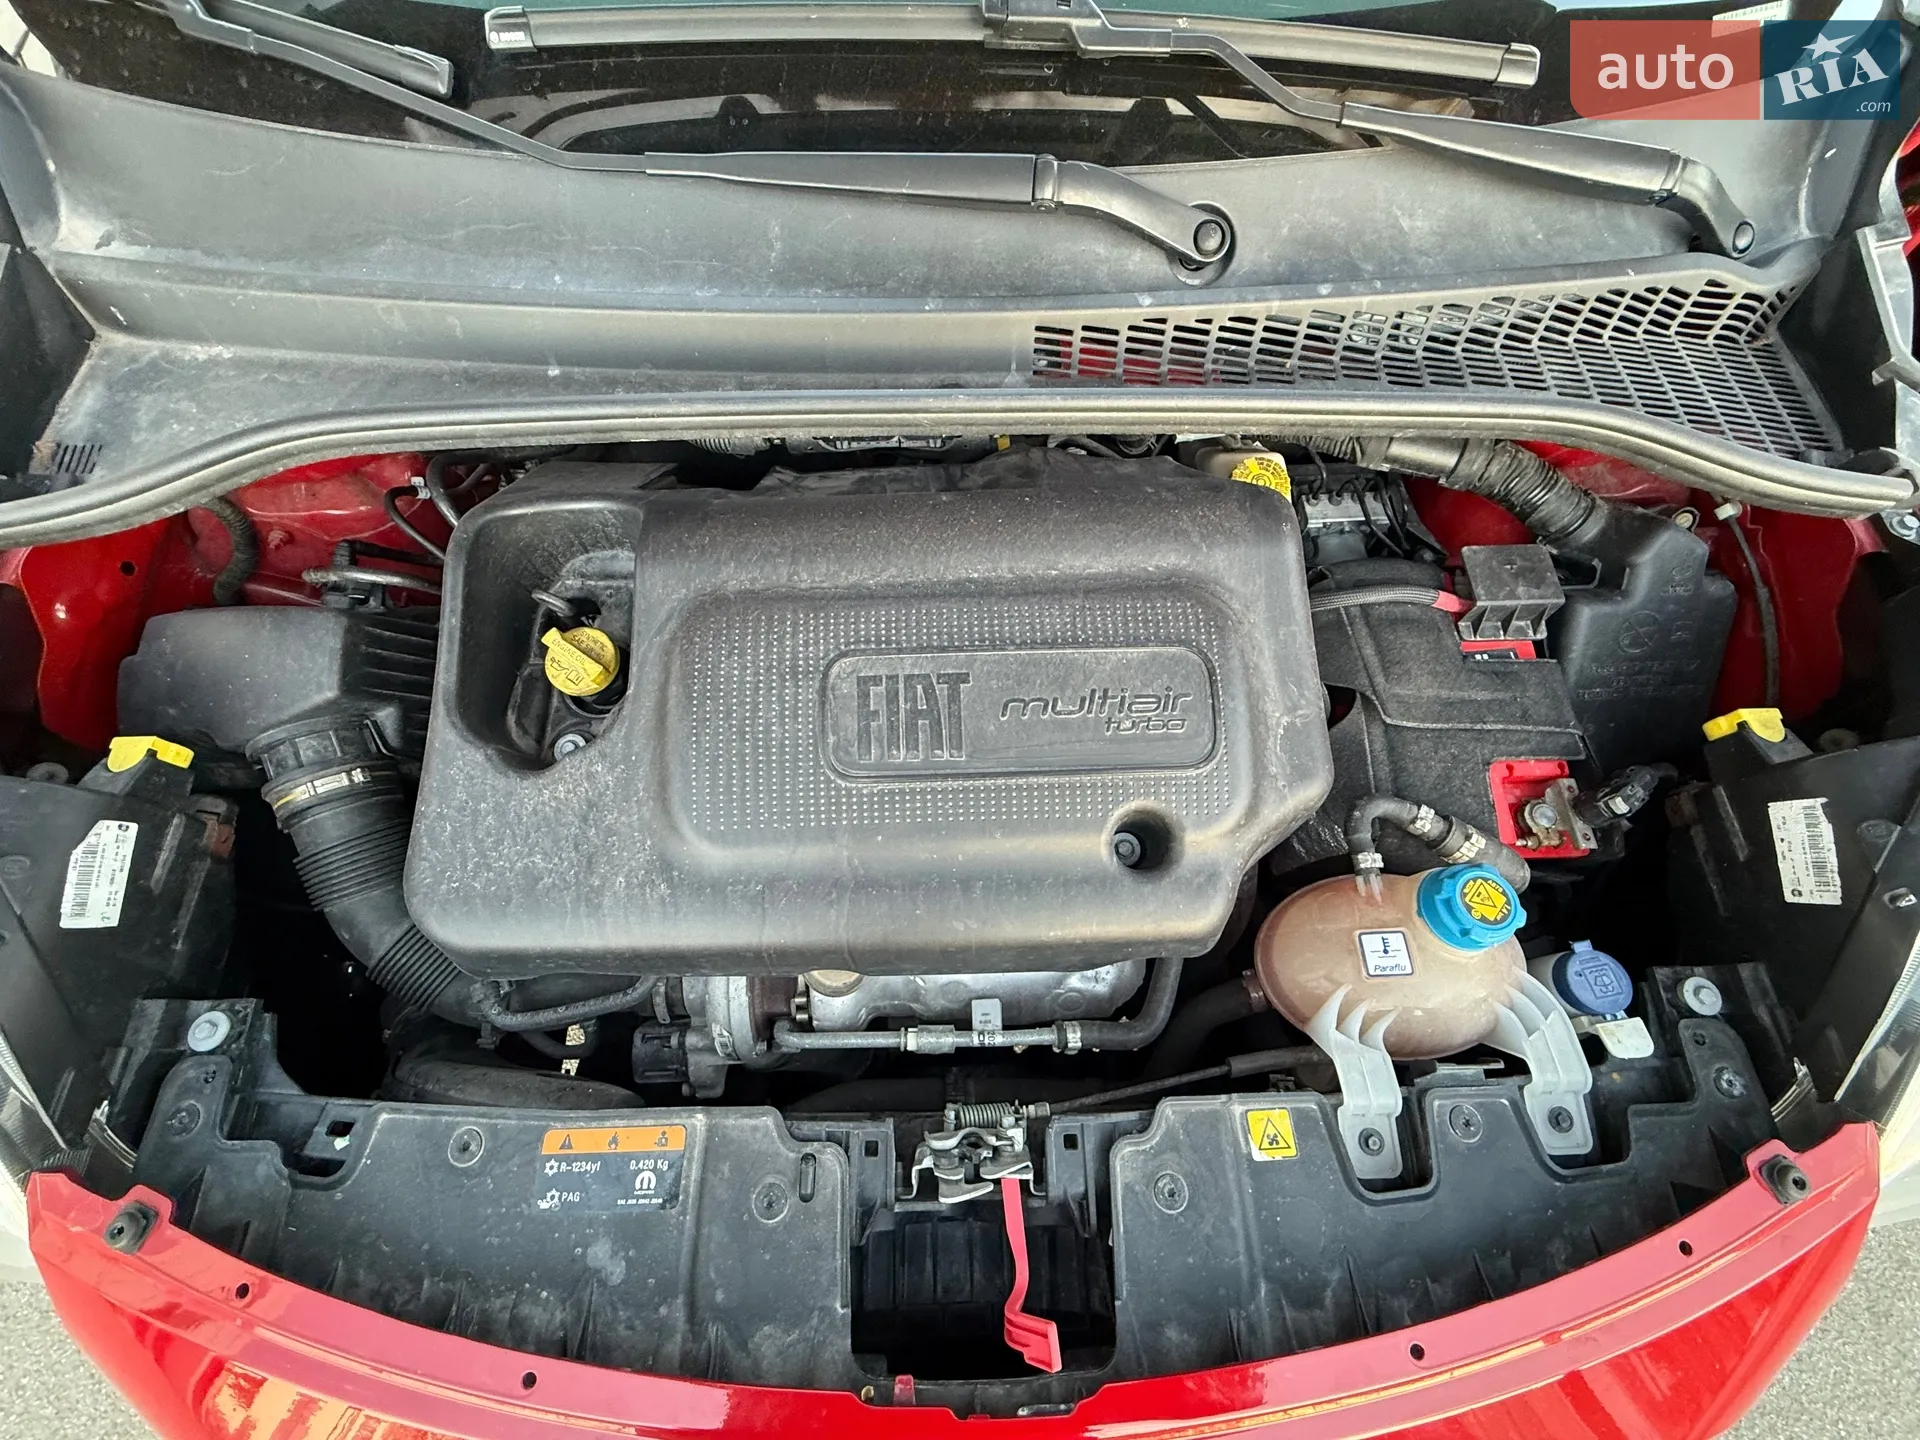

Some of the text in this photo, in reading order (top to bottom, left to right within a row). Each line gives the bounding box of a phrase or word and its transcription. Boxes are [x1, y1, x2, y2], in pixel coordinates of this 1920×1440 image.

[571, 635, 584, 646] SAE
[581, 631, 607, 651] SYNTHETIC
[551, 639, 587, 666] ENGINE OIL
[856, 671, 1194, 762] FIAT multiair
[1103, 717, 1187, 735] turbo
[1374, 963, 1407, 973] Paraflu
[559, 1161, 601, 1174] R-1234yf
[630, 1159, 669, 1171] 0.420 Kg
[561, 1192, 581, 1202] PAG
